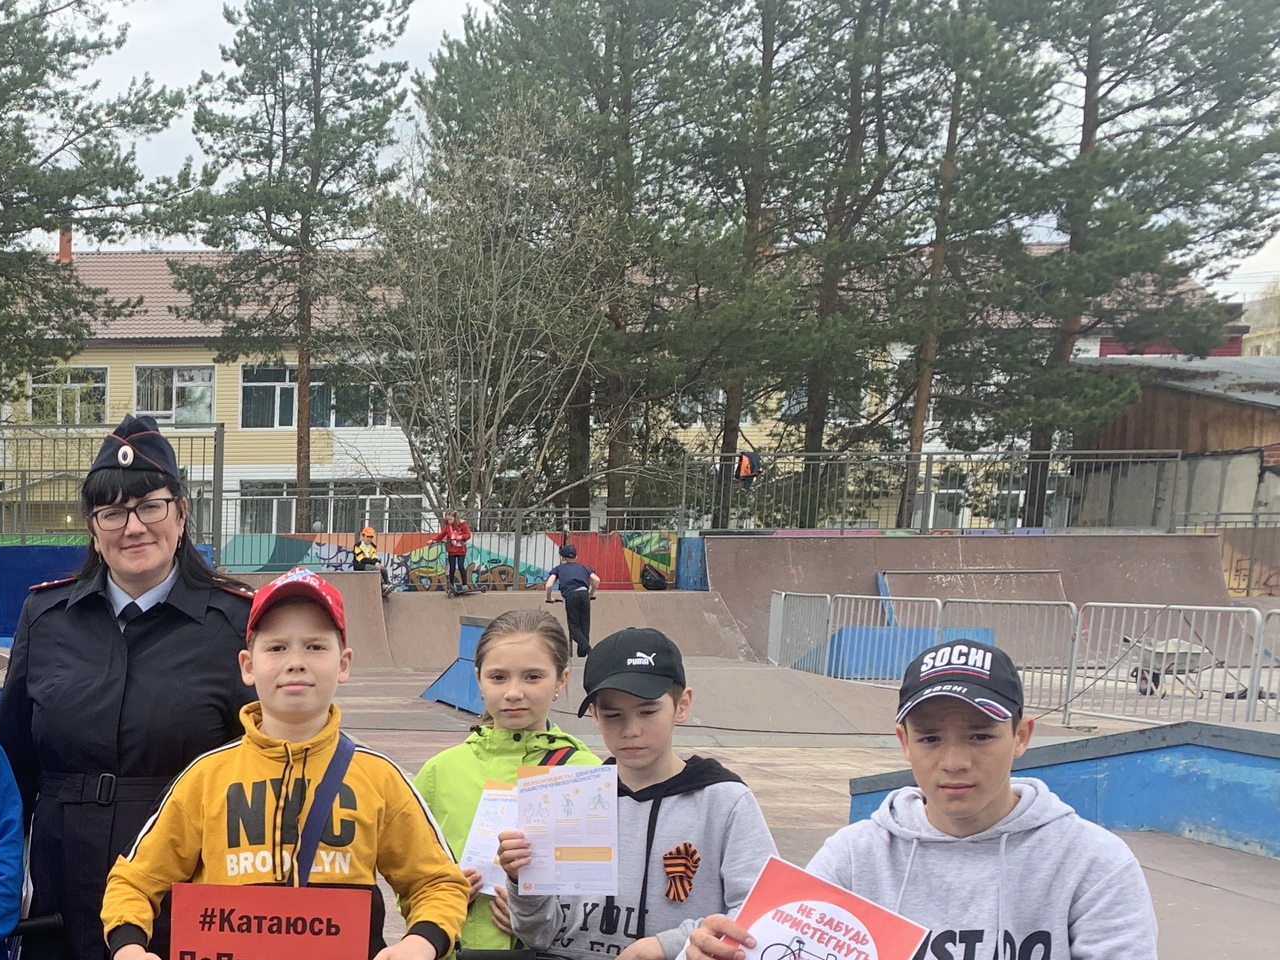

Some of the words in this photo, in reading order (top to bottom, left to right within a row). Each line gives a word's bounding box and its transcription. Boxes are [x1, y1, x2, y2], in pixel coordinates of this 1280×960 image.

[627, 658, 650, 666] PUMA
[920, 645, 993, 673] SOCHI
[923, 684, 968, 695] SOCHI
[226, 778, 357, 848] NYC
[199, 907, 341, 937] #Катаюсь
[796, 903, 817, 920] НЕ
[816, 912, 870, 947] ЗАБУДЬ
